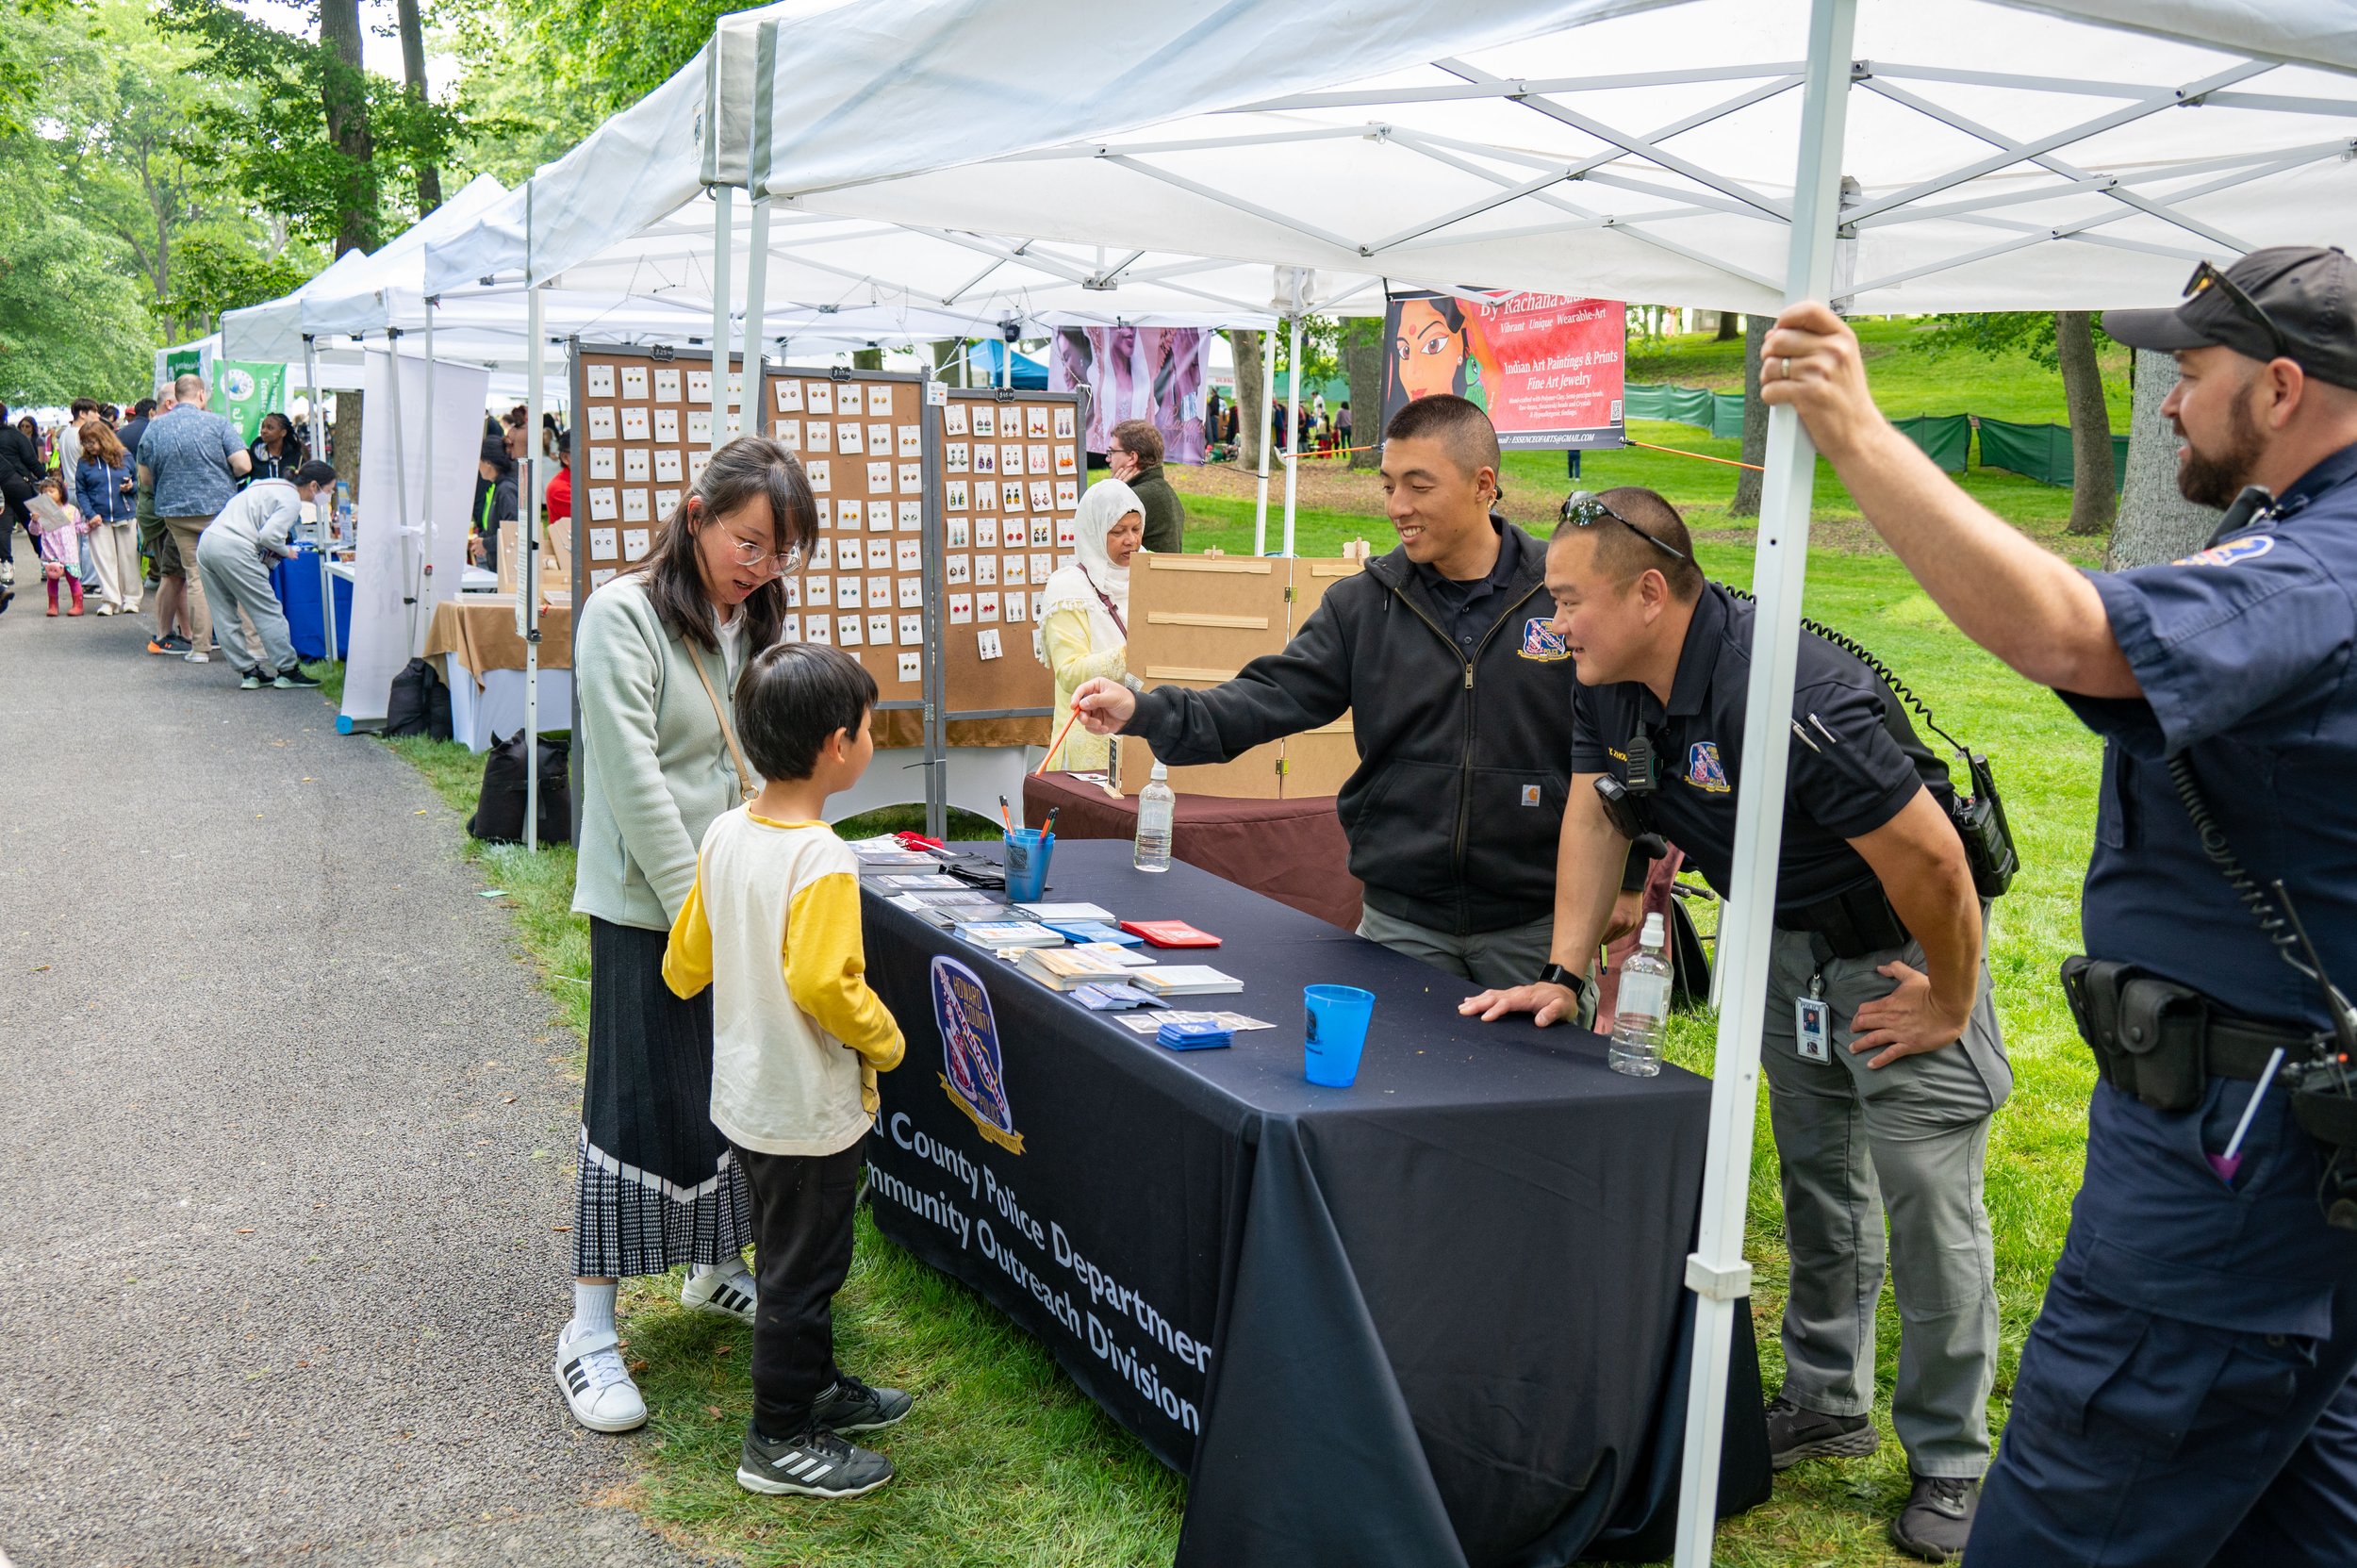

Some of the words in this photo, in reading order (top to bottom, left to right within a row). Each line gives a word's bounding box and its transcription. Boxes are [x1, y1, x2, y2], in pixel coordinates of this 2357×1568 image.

[1500, 322, 1525, 333] Vibrant
[1529, 318, 1554, 331] Unique
[1557, 307, 1607, 325] Wearable-Art
[1504, 360, 1531, 374] Indian
[1532, 359, 1546, 371] Art
[1547, 355, 1584, 371] Paintings
[1585, 352, 1592, 365] &
[1593, 349, 1618, 365] Prints
[1527, 376, 1545, 390] Fine
[1546, 375, 1558, 388] Art
[1558, 371, 1591, 390] Jewelry
[953, 974, 982, 1010] HOWARD
[964, 1001, 991, 1036] COUNTY
[955, 1001, 1005, 1114] MARYLAND
[890, 1112, 979, 1199] County
[983, 1164, 1046, 1251] Police
[1050, 1220, 1212, 1374] Departmen
[865, 1157, 970, 1250] mmunity
[977, 1218, 1082, 1341] Outreach
[1086, 1311, 1200, 1437] Division
